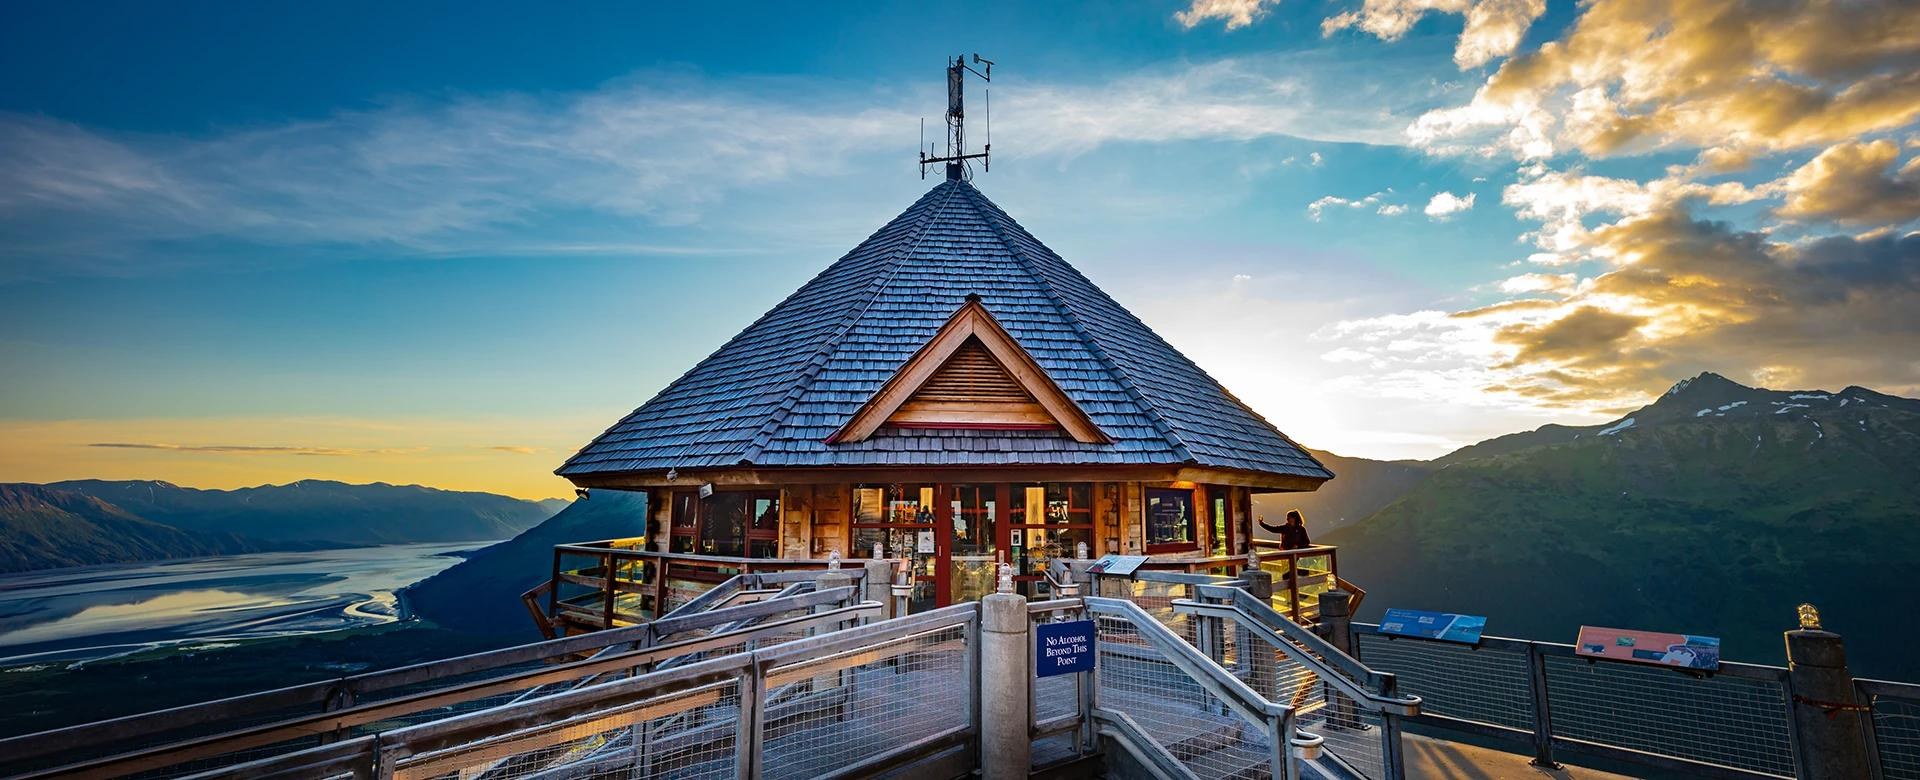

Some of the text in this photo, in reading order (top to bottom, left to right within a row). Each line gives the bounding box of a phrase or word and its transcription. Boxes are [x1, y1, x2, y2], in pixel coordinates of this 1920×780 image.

[1046, 635, 1087, 646] NO ALCOHOL
[1046, 644, 1087, 657] BEYOND THIS
[1057, 656, 1077, 666] POINT
